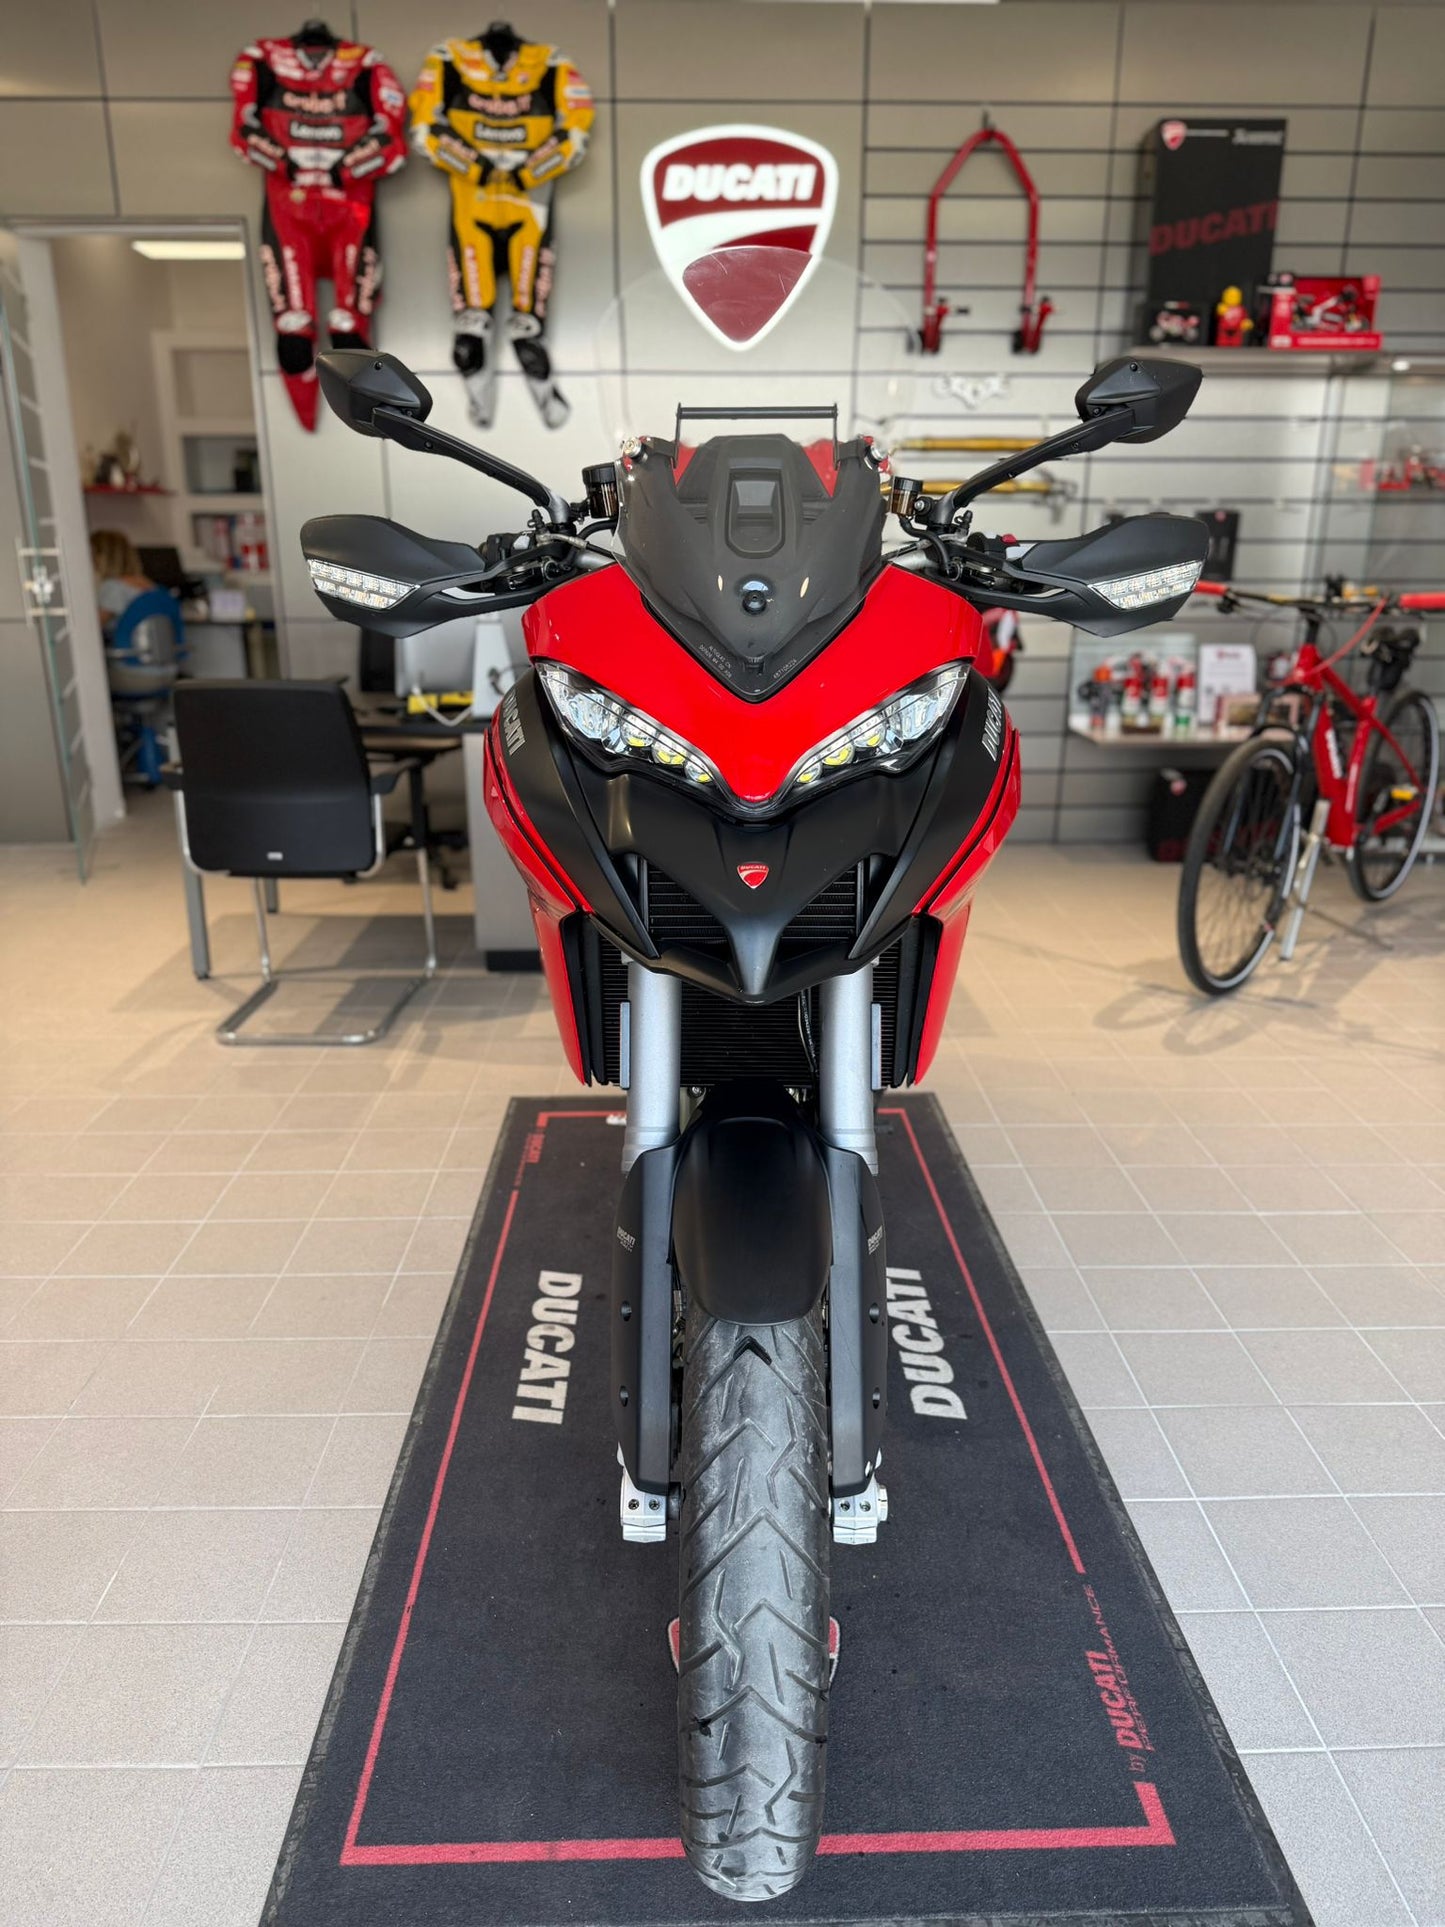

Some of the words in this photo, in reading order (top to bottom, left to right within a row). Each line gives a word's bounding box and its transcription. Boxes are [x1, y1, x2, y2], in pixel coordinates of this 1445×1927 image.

[662, 163, 817, 201] DUCATI
[512, 1269, 583, 1425] DUCATI
[886, 1267, 968, 1420] DUCATI
[1085, 1650, 1144, 1750] DUCATI
